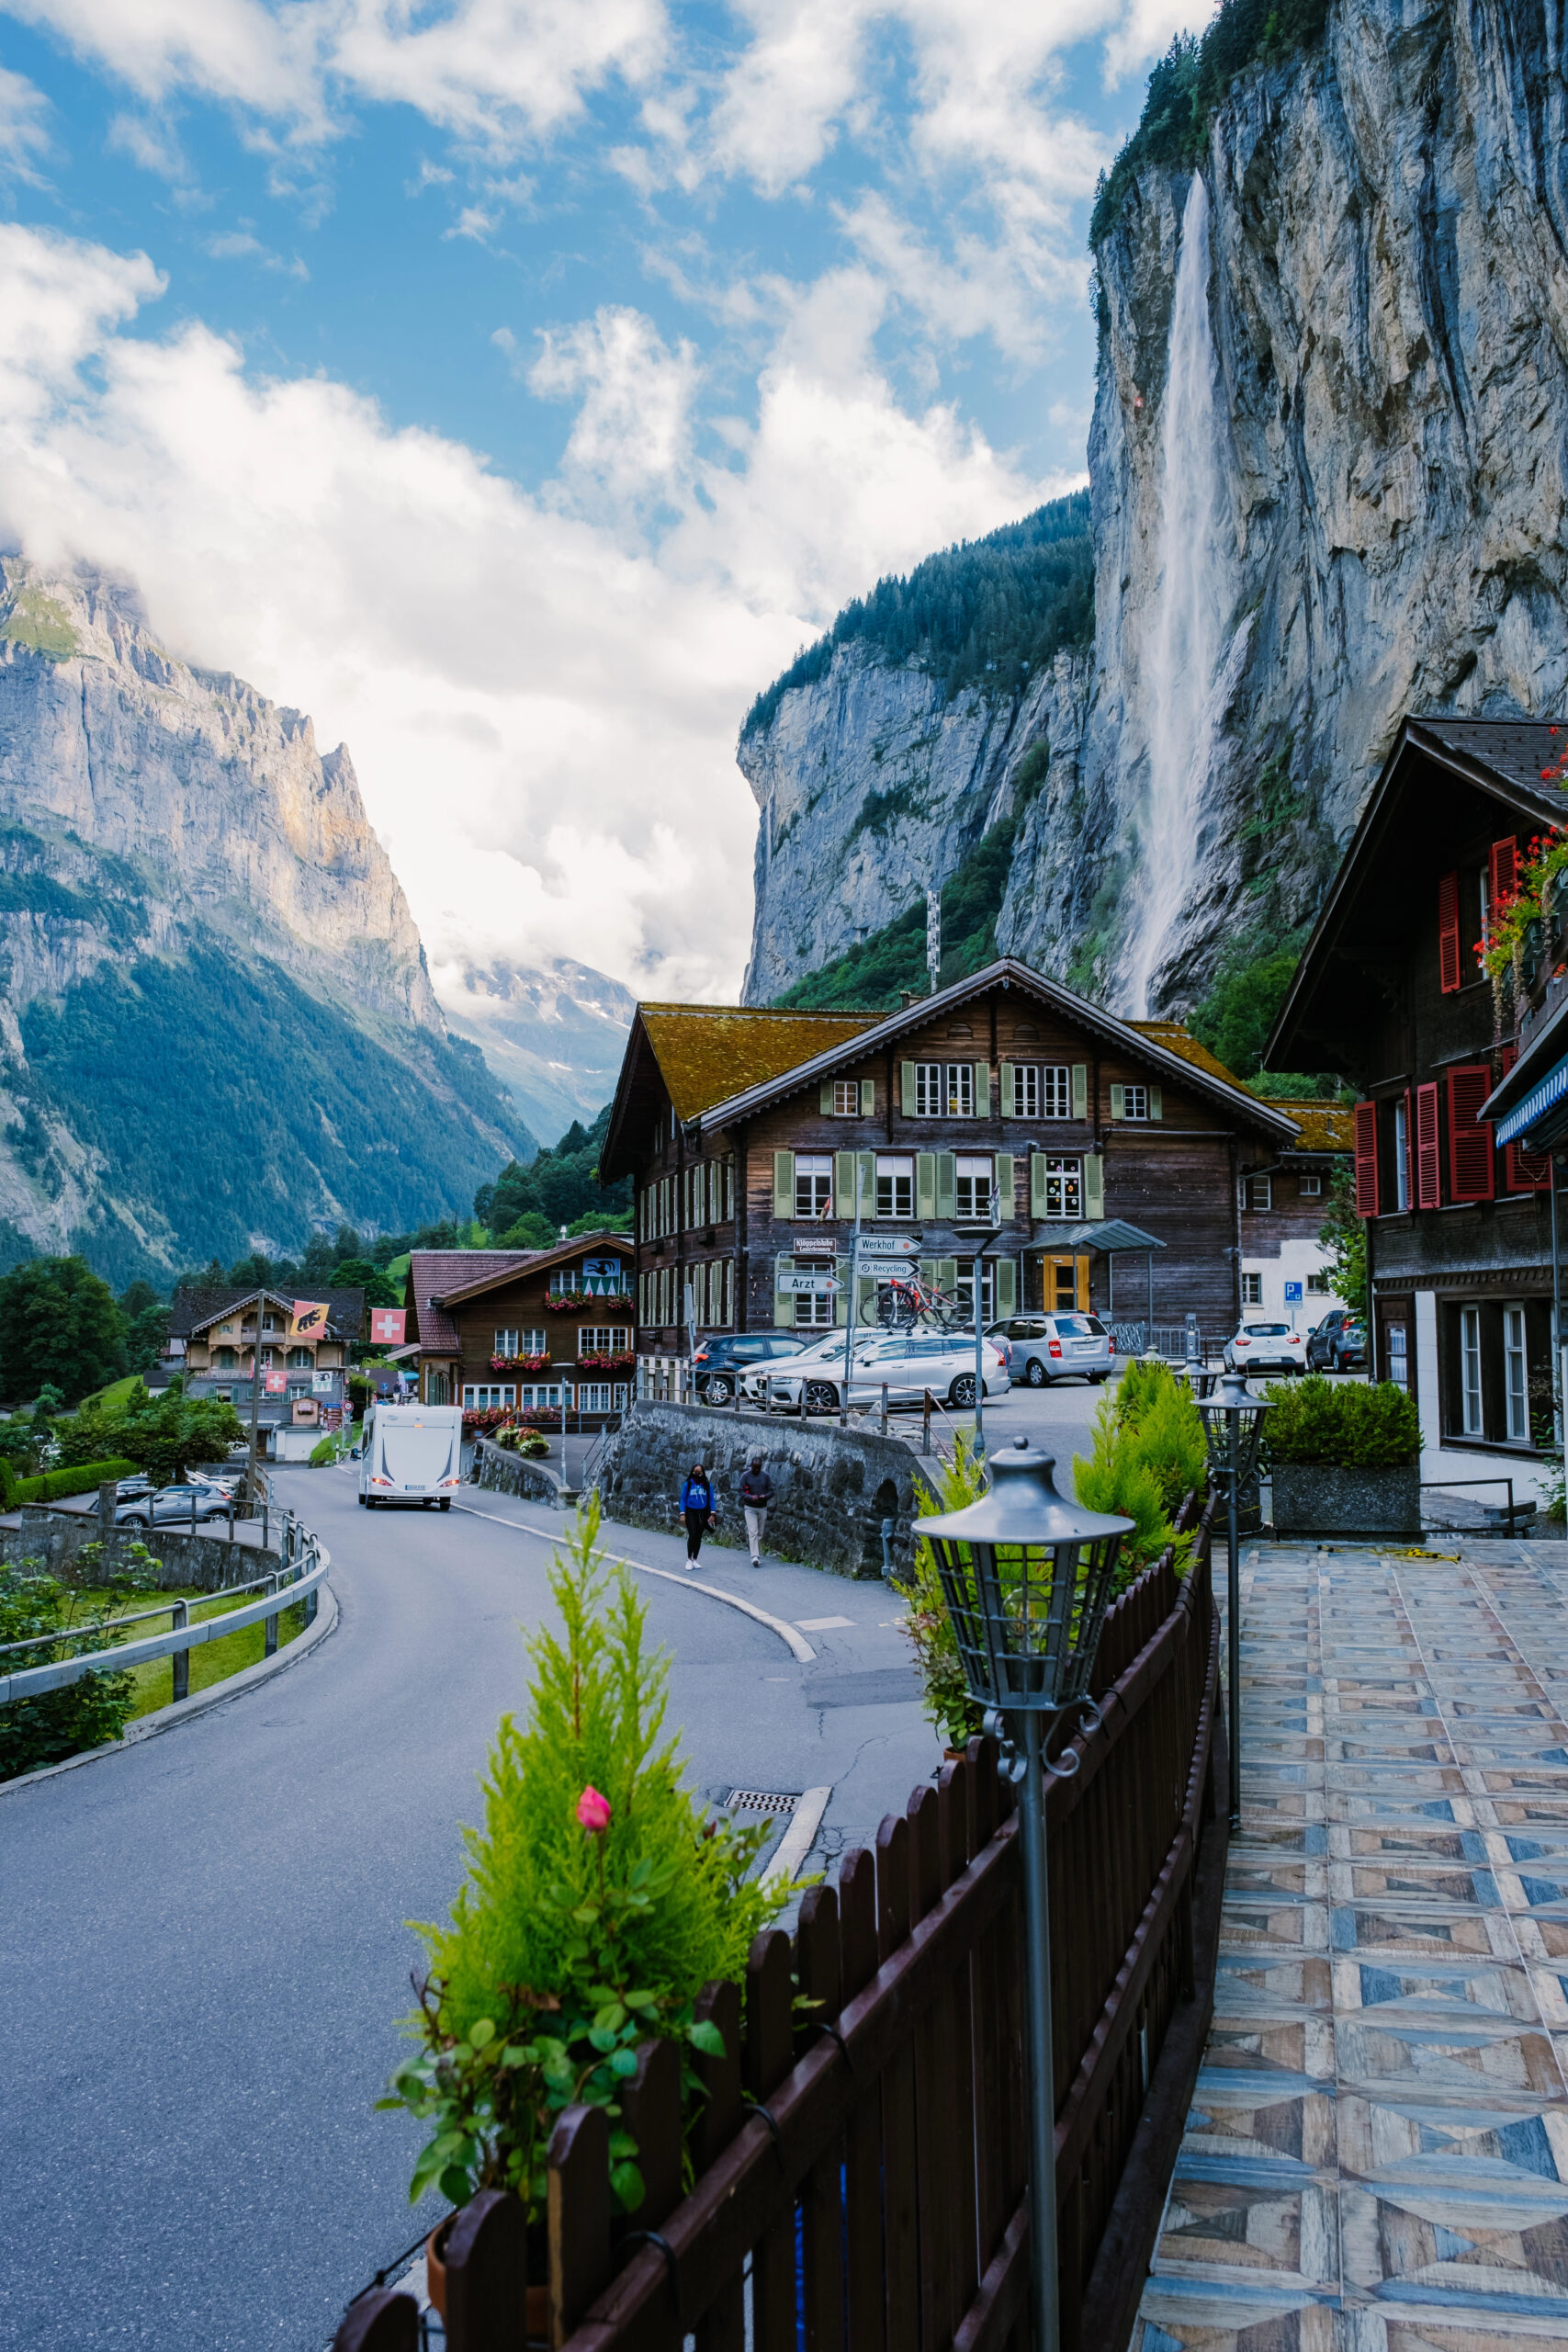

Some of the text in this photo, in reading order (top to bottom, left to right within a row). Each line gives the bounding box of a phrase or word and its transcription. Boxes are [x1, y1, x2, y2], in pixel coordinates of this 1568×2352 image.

[862, 1239, 896, 1250] Werkhof
[874, 1264, 907, 1274] Recycling
[792, 1278, 816, 1288] Arzt
[1287, 1283, 1294, 1297] P
